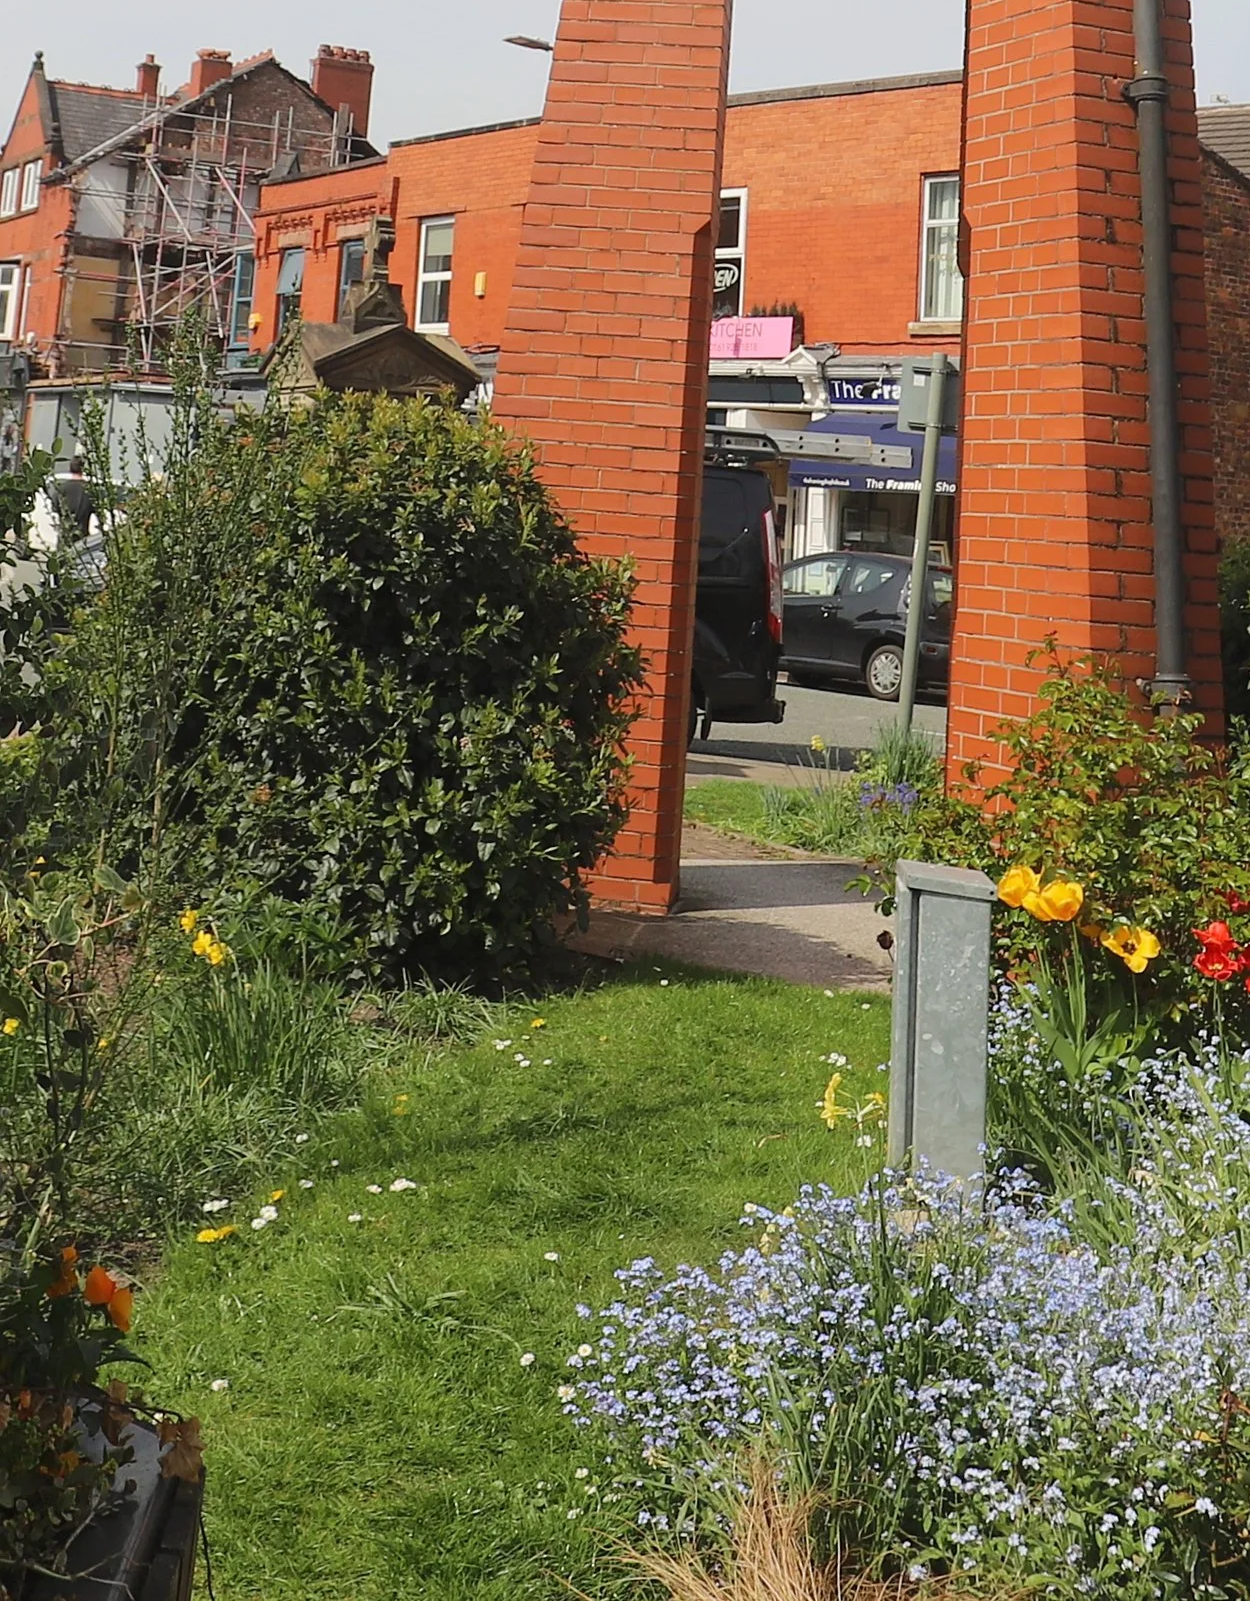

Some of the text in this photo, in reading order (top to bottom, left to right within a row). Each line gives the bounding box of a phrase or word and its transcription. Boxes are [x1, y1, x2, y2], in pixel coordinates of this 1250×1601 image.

[830, 380, 865, 398] The
[865, 478, 884, 489] The
[935, 481, 957, 493] Sho
